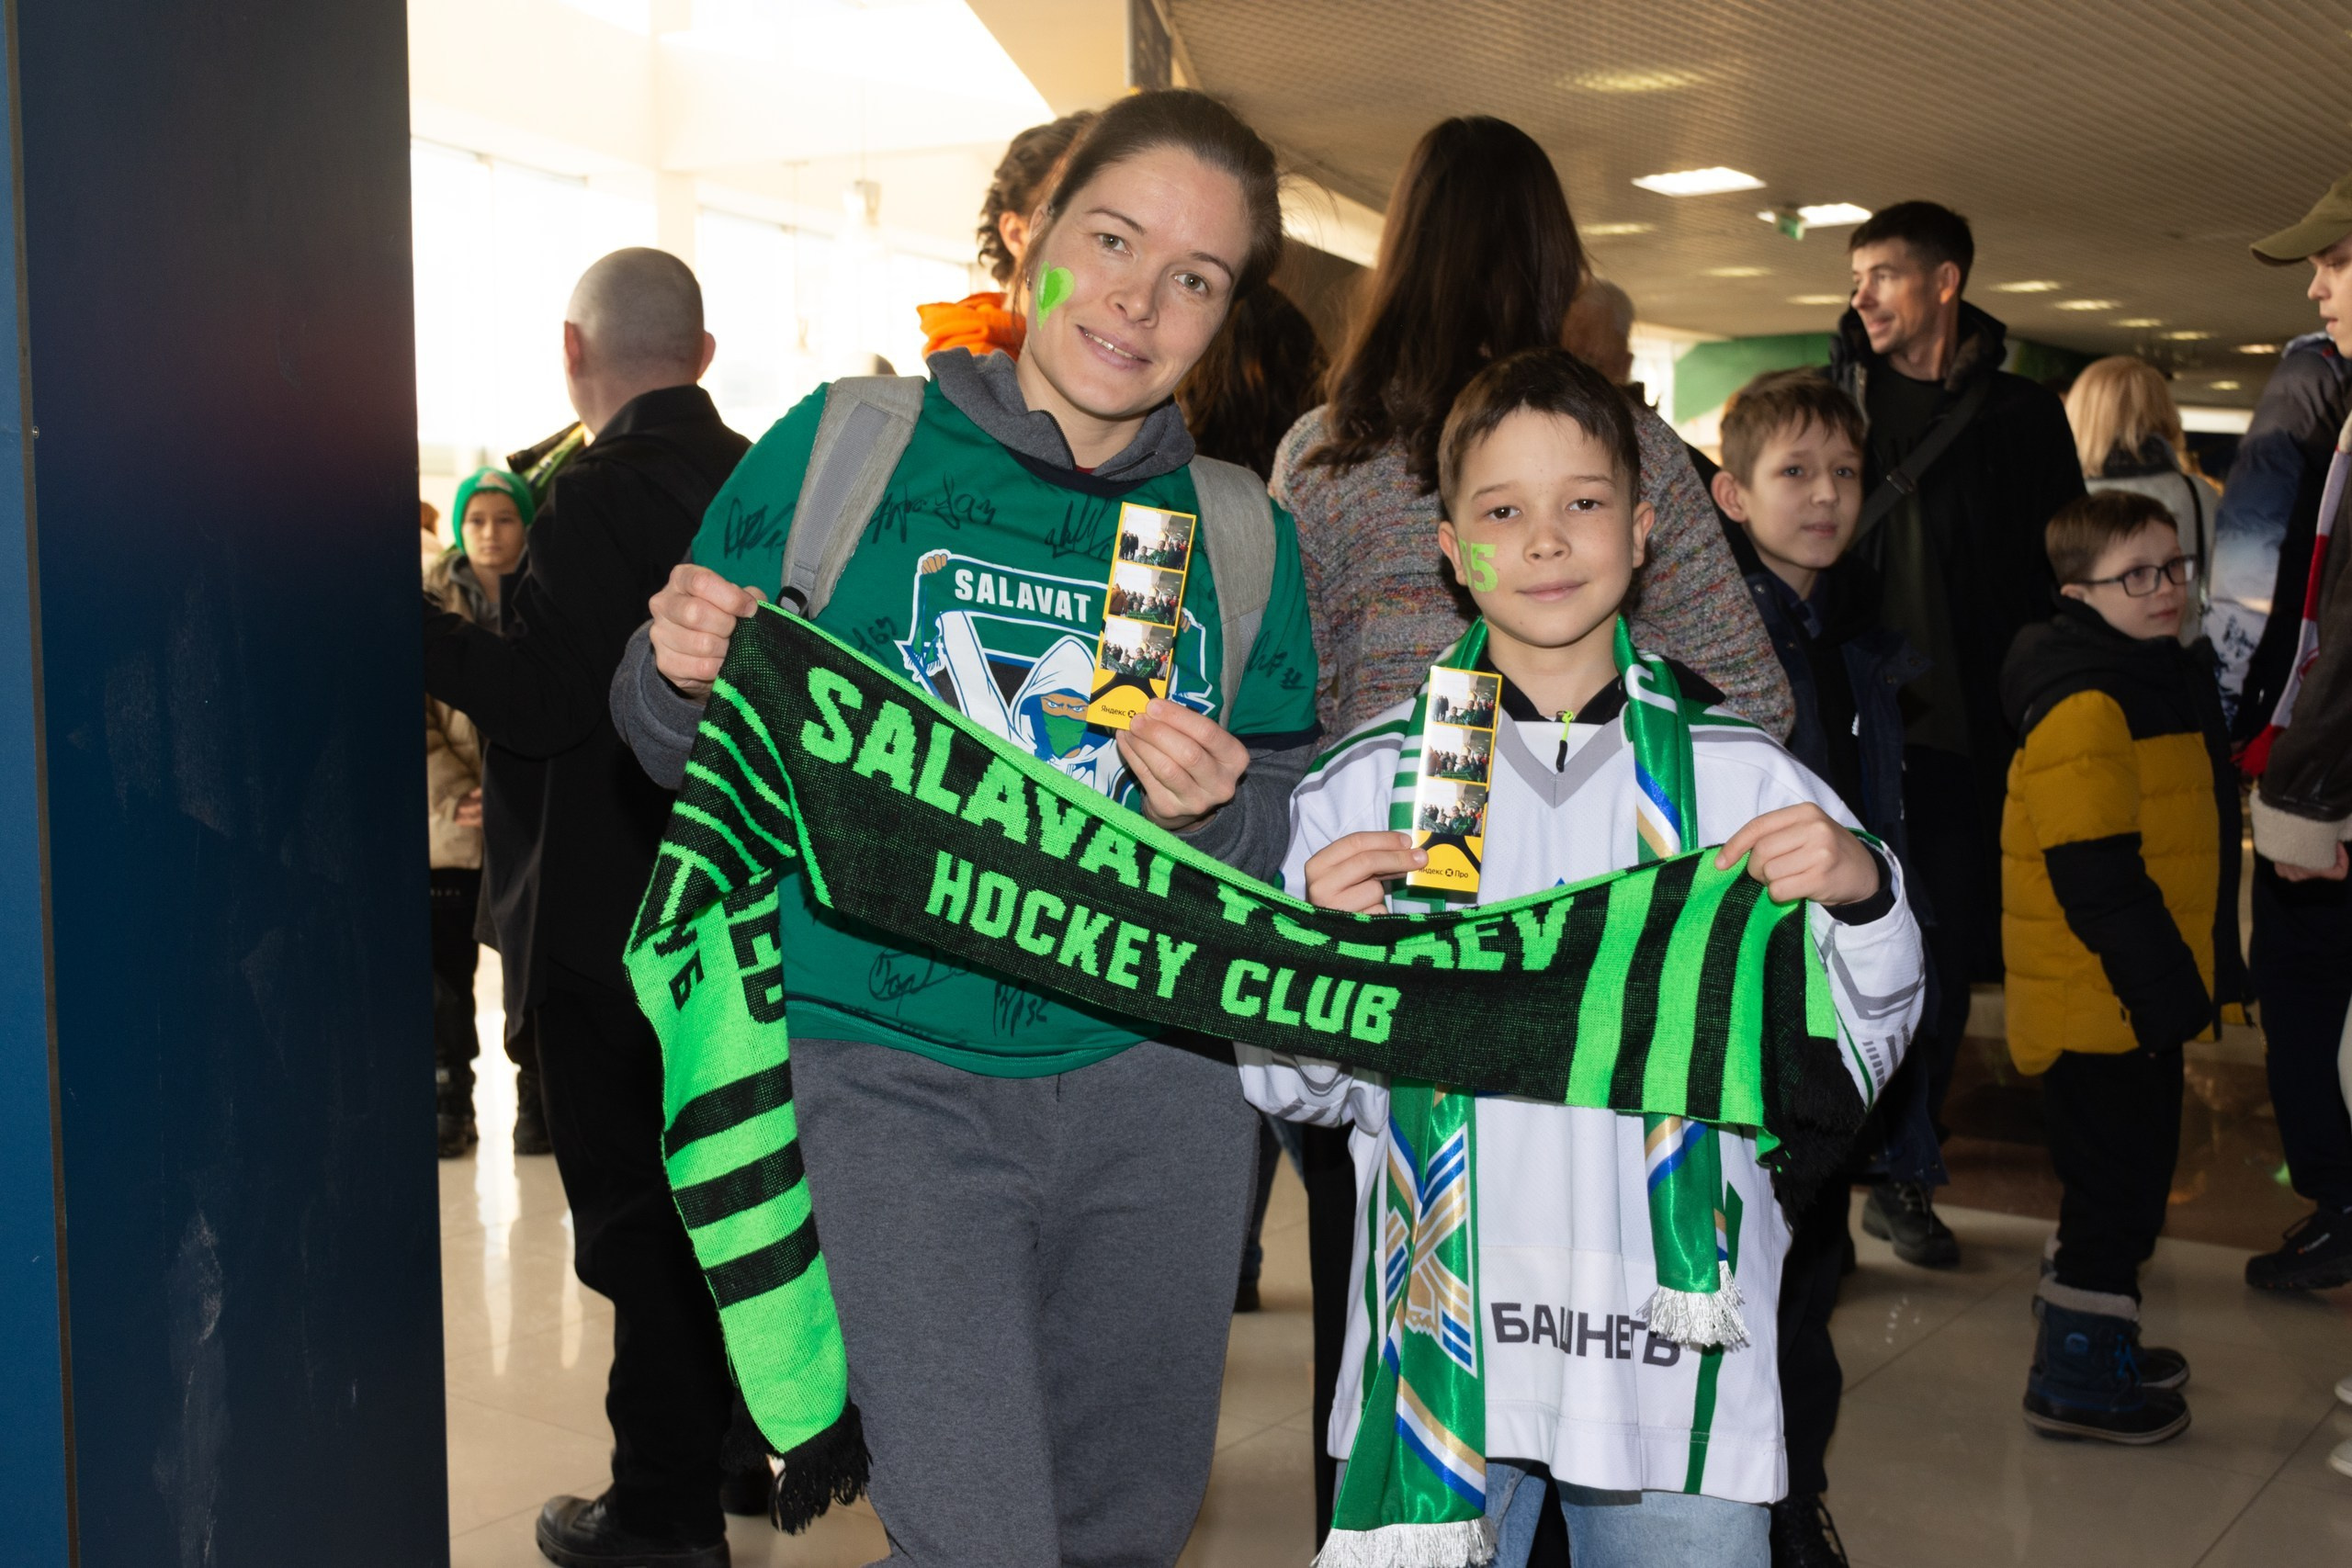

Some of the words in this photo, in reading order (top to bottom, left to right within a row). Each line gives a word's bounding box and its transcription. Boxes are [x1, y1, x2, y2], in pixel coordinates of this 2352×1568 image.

[955, 569, 1091, 624] SALAVAT
[1101, 705, 1127, 716] Яндекс
[1454, 869, 1469, 879] Про
[924, 850, 1198, 999] HOCKEY
[1220, 959, 1402, 1044] CLUB
